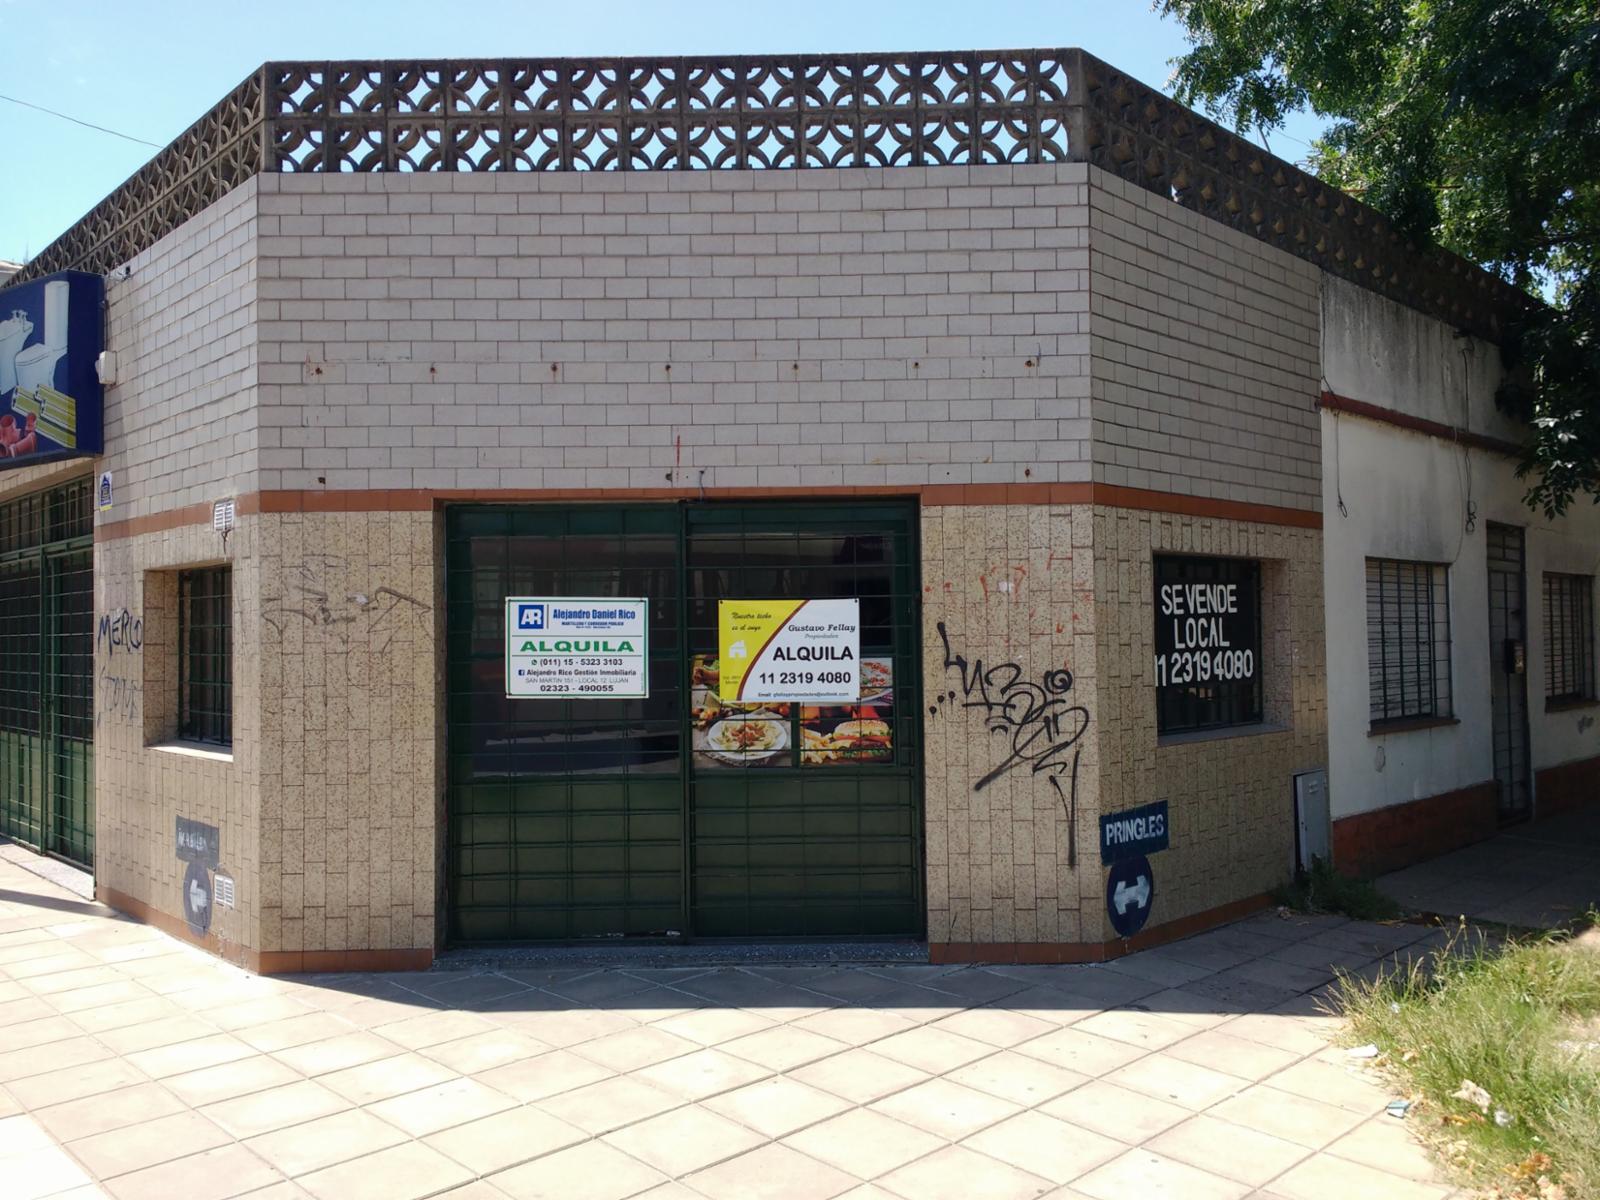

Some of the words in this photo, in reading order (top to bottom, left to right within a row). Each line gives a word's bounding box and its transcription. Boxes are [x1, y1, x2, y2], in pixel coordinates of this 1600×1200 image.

[1161, 584, 1184, 615] SE
[1185, 584, 1238, 614] VENDE
[520, 608, 543, 626] AR
[553, 609, 591, 620] Alejandro
[592, 609, 617, 620] Daniel
[618, 609, 636, 620] Rico
[788, 624, 825, 632] Gustavo
[826, 623, 856, 633] Fellay
[1174, 617, 1230, 649] LOCAL
[520, 641, 634, 653] ALQUILA
[773, 646, 853, 661] ALQUILA
[540, 658, 561, 667] (011)
[1171, 650, 1211, 684] 2319
[1213, 649, 1254, 681] 4080
[526, 669, 557, 677] Alejandro
[759, 672, 775, 684] 11
[779, 672, 814, 684] 2319
[817, 671, 851, 684] 4080
[1105, 814, 1165, 846] PRINGLES
